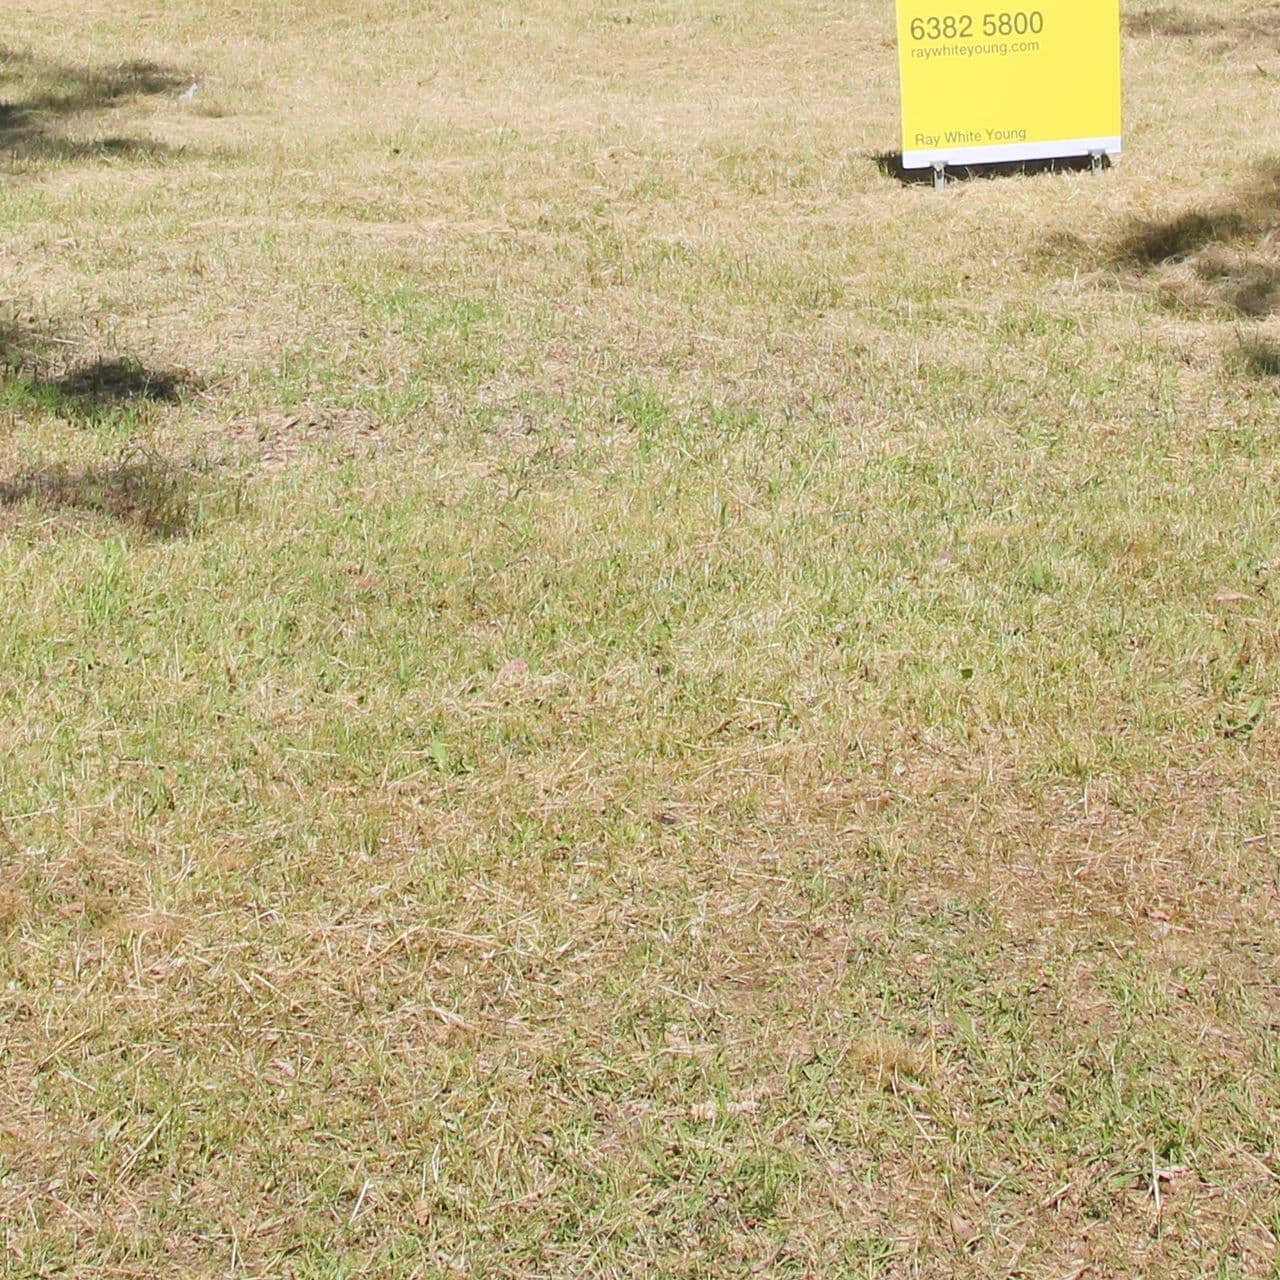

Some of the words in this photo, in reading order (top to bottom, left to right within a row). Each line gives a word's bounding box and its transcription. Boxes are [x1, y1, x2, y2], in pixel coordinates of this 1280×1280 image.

[910, 15, 973, 40] 6382
[983, 11, 1044, 37] 5800
[911, 40, 1040, 60] raywhiteyoung.com
[915, 133, 941, 147] Ray
[944, 130, 982, 144] White
[985, 128, 1027, 143] Young
